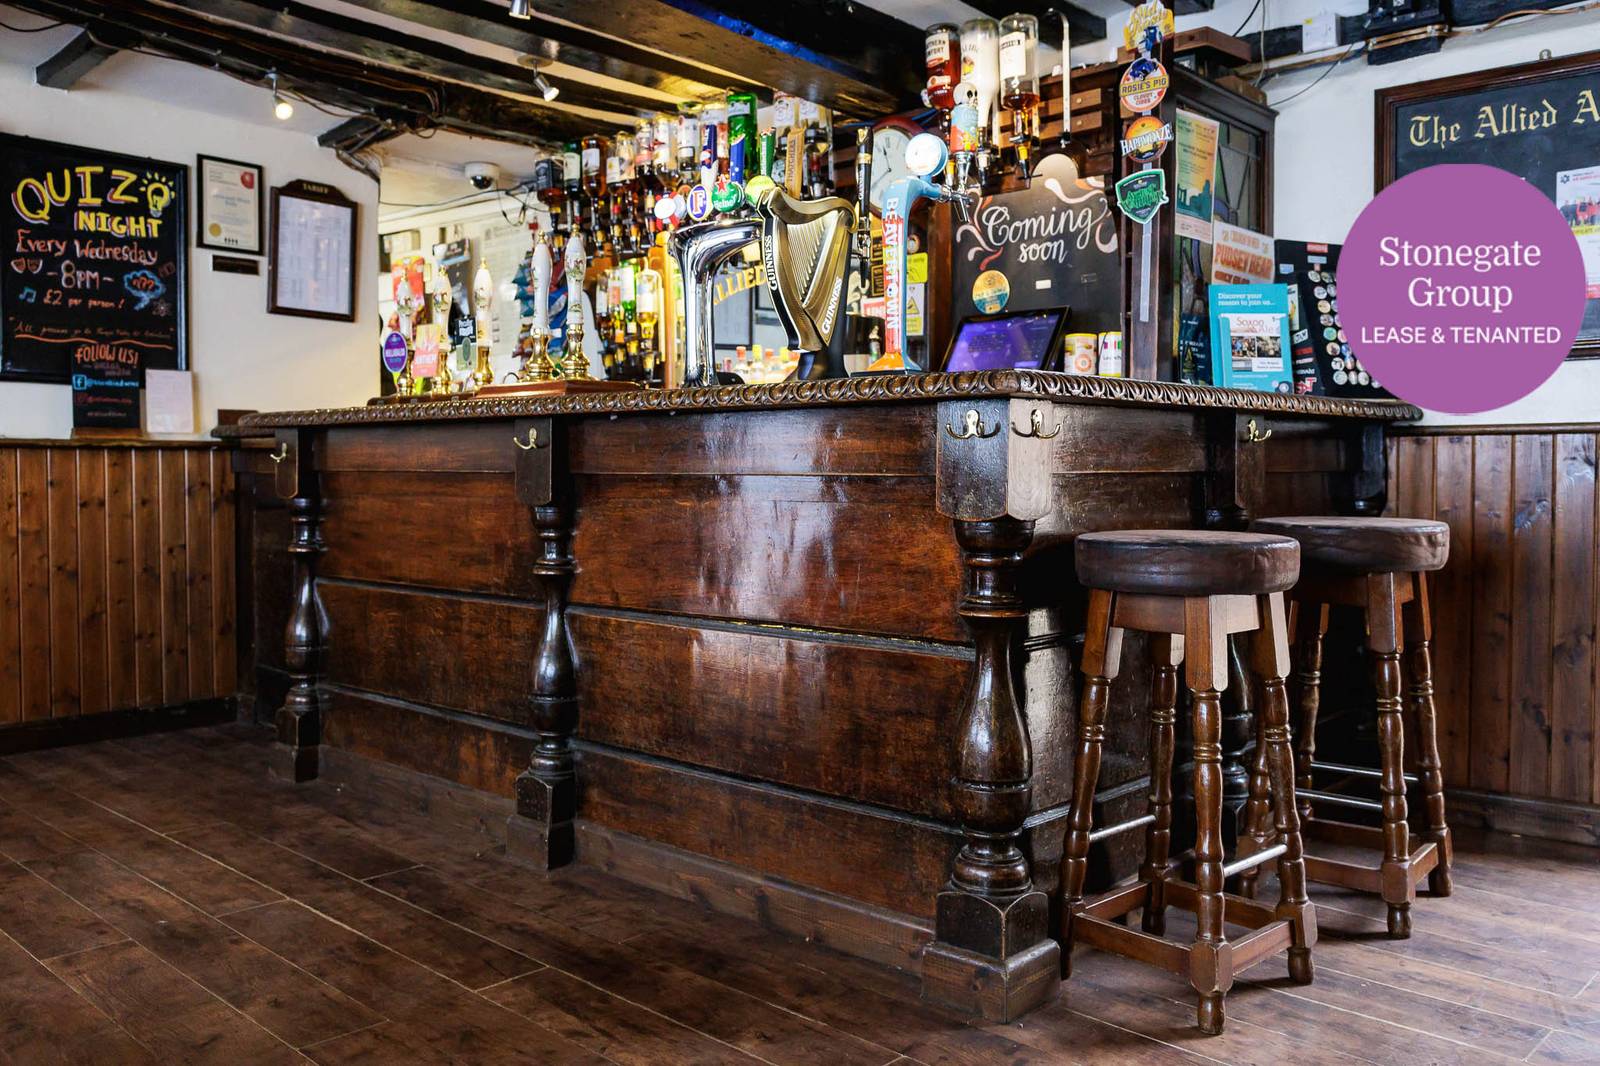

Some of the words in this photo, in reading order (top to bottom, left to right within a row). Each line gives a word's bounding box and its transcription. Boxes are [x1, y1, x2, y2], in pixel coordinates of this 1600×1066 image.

[1122, 81, 1151, 95] ROSIE'S
[1153, 77, 1167, 89] PIG
[1409, 115, 1461, 149] The
[1474, 99, 1557, 139] Allied
[11, 166, 139, 224] QUIZ
[74, 210, 163, 238] NIGHT
[982, 200, 1106, 250] Coming
[16, 229, 67, 256] Every
[74, 240, 158, 265] Wednesday
[764, 235, 778, 291] GUINNESS
[883, 197, 900, 329] BEAVERTOWN
[1018, 239, 1068, 264] soon
[43, 289, 62, 305] £2
[68, 298, 82, 308] per
[821, 277, 842, 334] GUINNESS
[118, 347, 139, 369] US!
